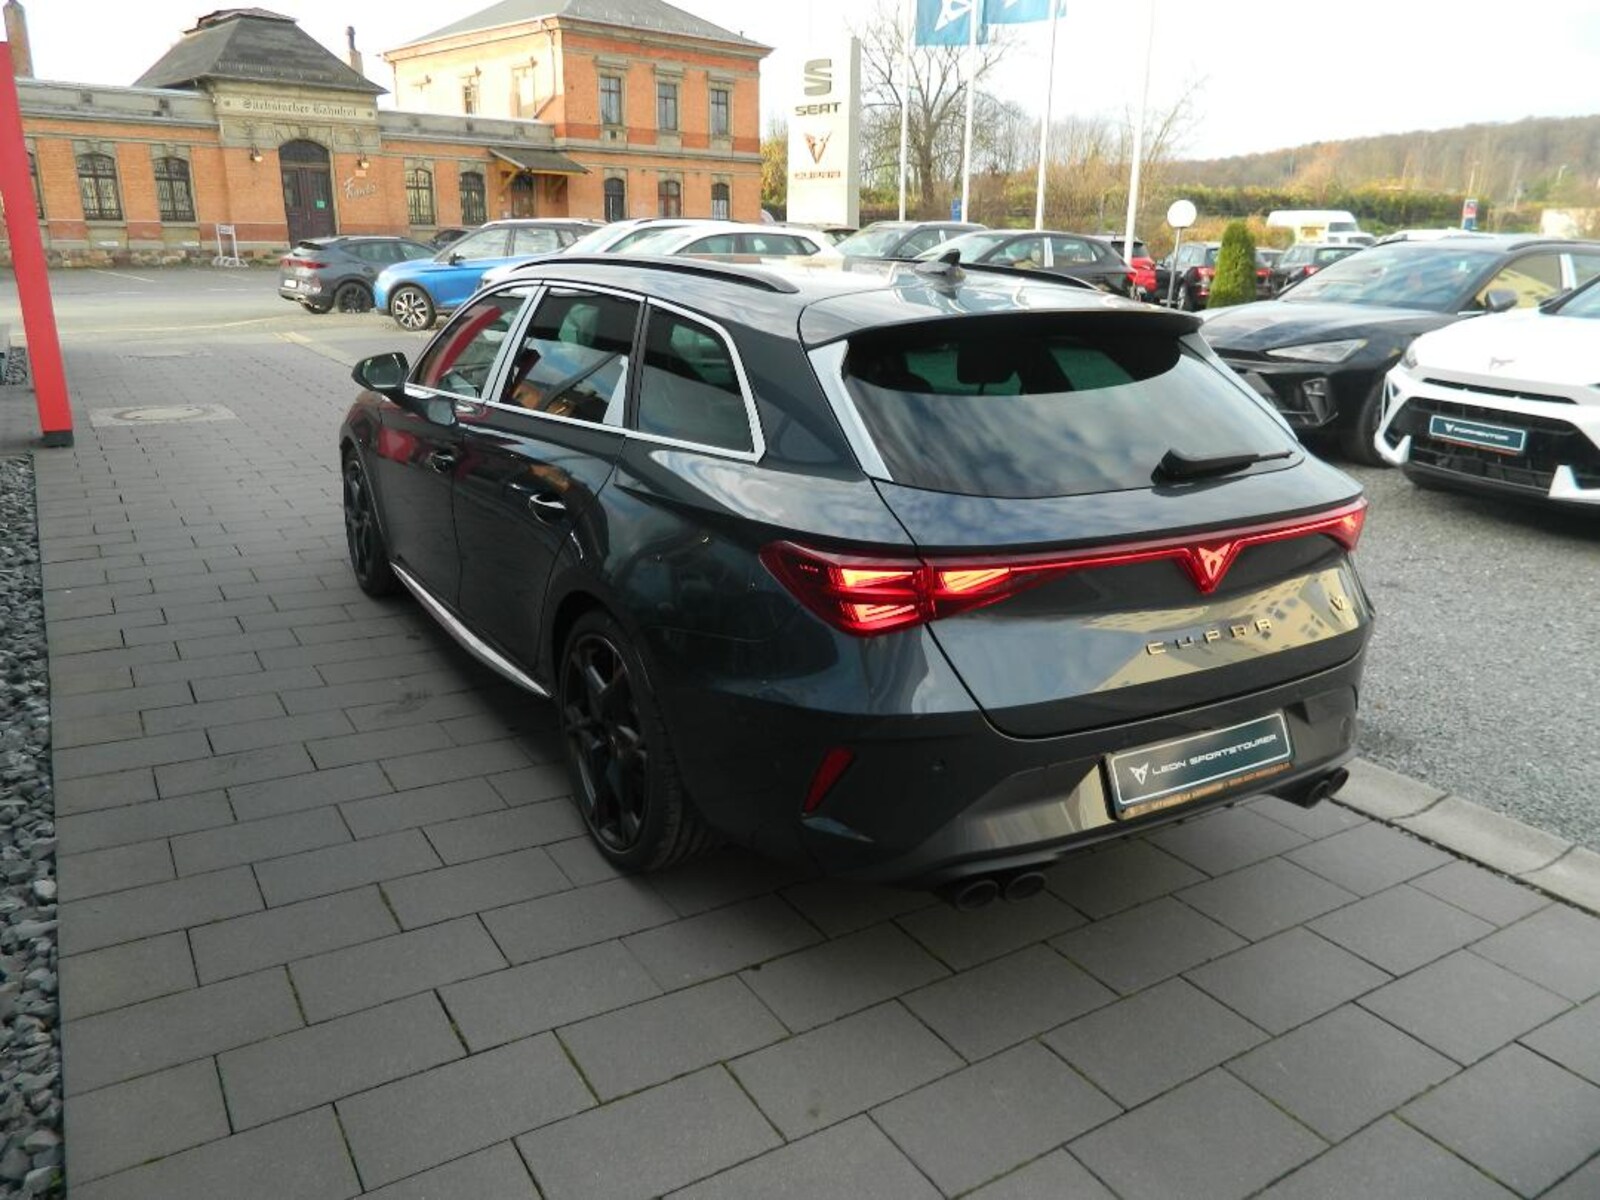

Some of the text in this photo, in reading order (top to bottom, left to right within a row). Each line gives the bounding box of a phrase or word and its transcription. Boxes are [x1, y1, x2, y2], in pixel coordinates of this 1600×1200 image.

[794, 101, 842, 117] SEAT
[1146, 618, 1273, 656] CUPRA
[1151, 733, 1278, 776] LEON SPORTSTOURER
